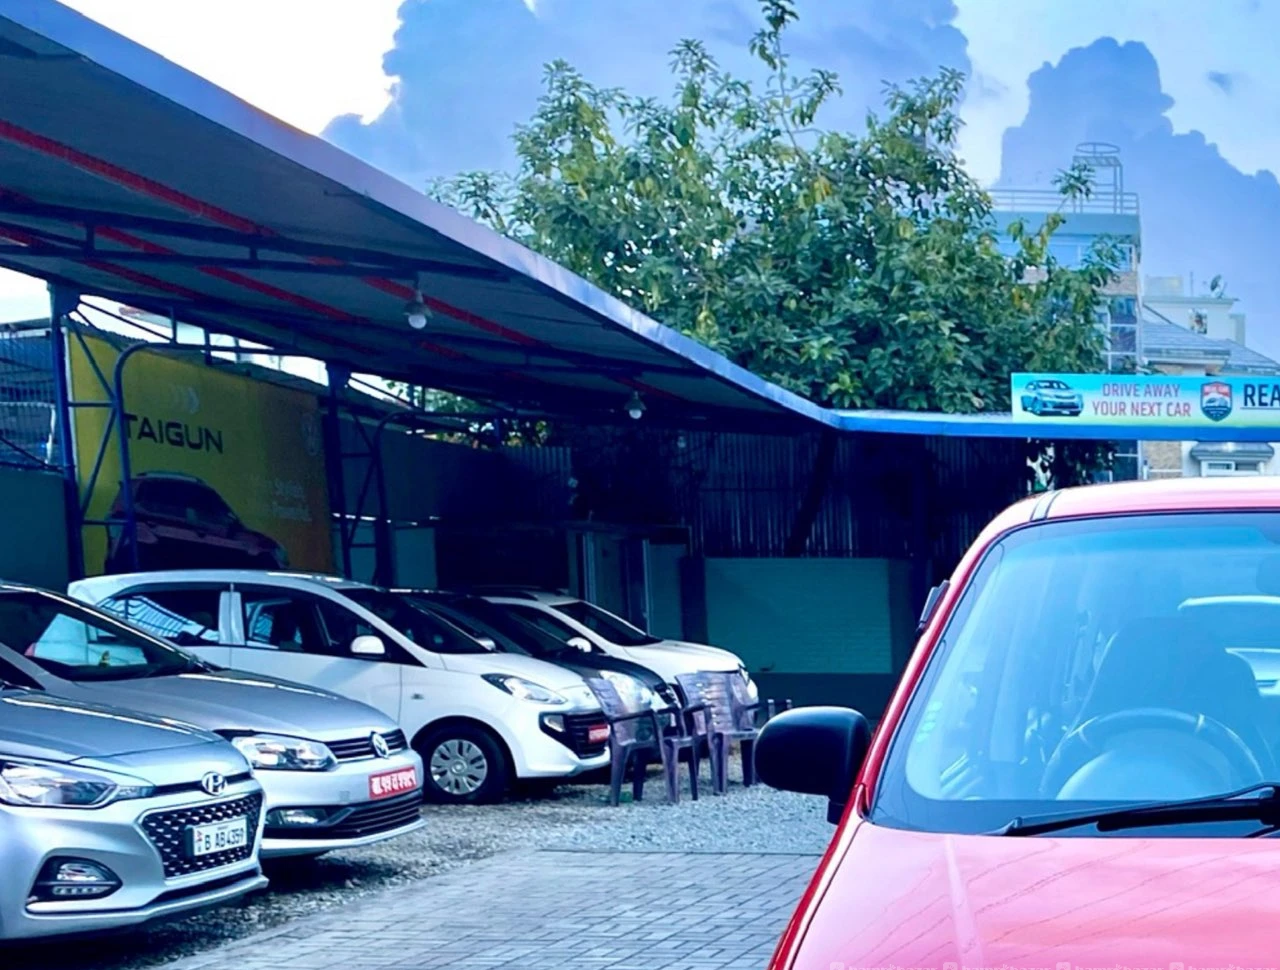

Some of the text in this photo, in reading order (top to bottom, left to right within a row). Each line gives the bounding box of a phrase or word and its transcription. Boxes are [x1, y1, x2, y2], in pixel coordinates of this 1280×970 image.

[1102, 383, 1181, 398] DRIVE AWAY
[1092, 402, 1127, 417] YOUR
[1130, 402, 1164, 417] NEXT
[1166, 402, 1191, 418] CAR
[123, 412, 224, 454] TAIGUN
